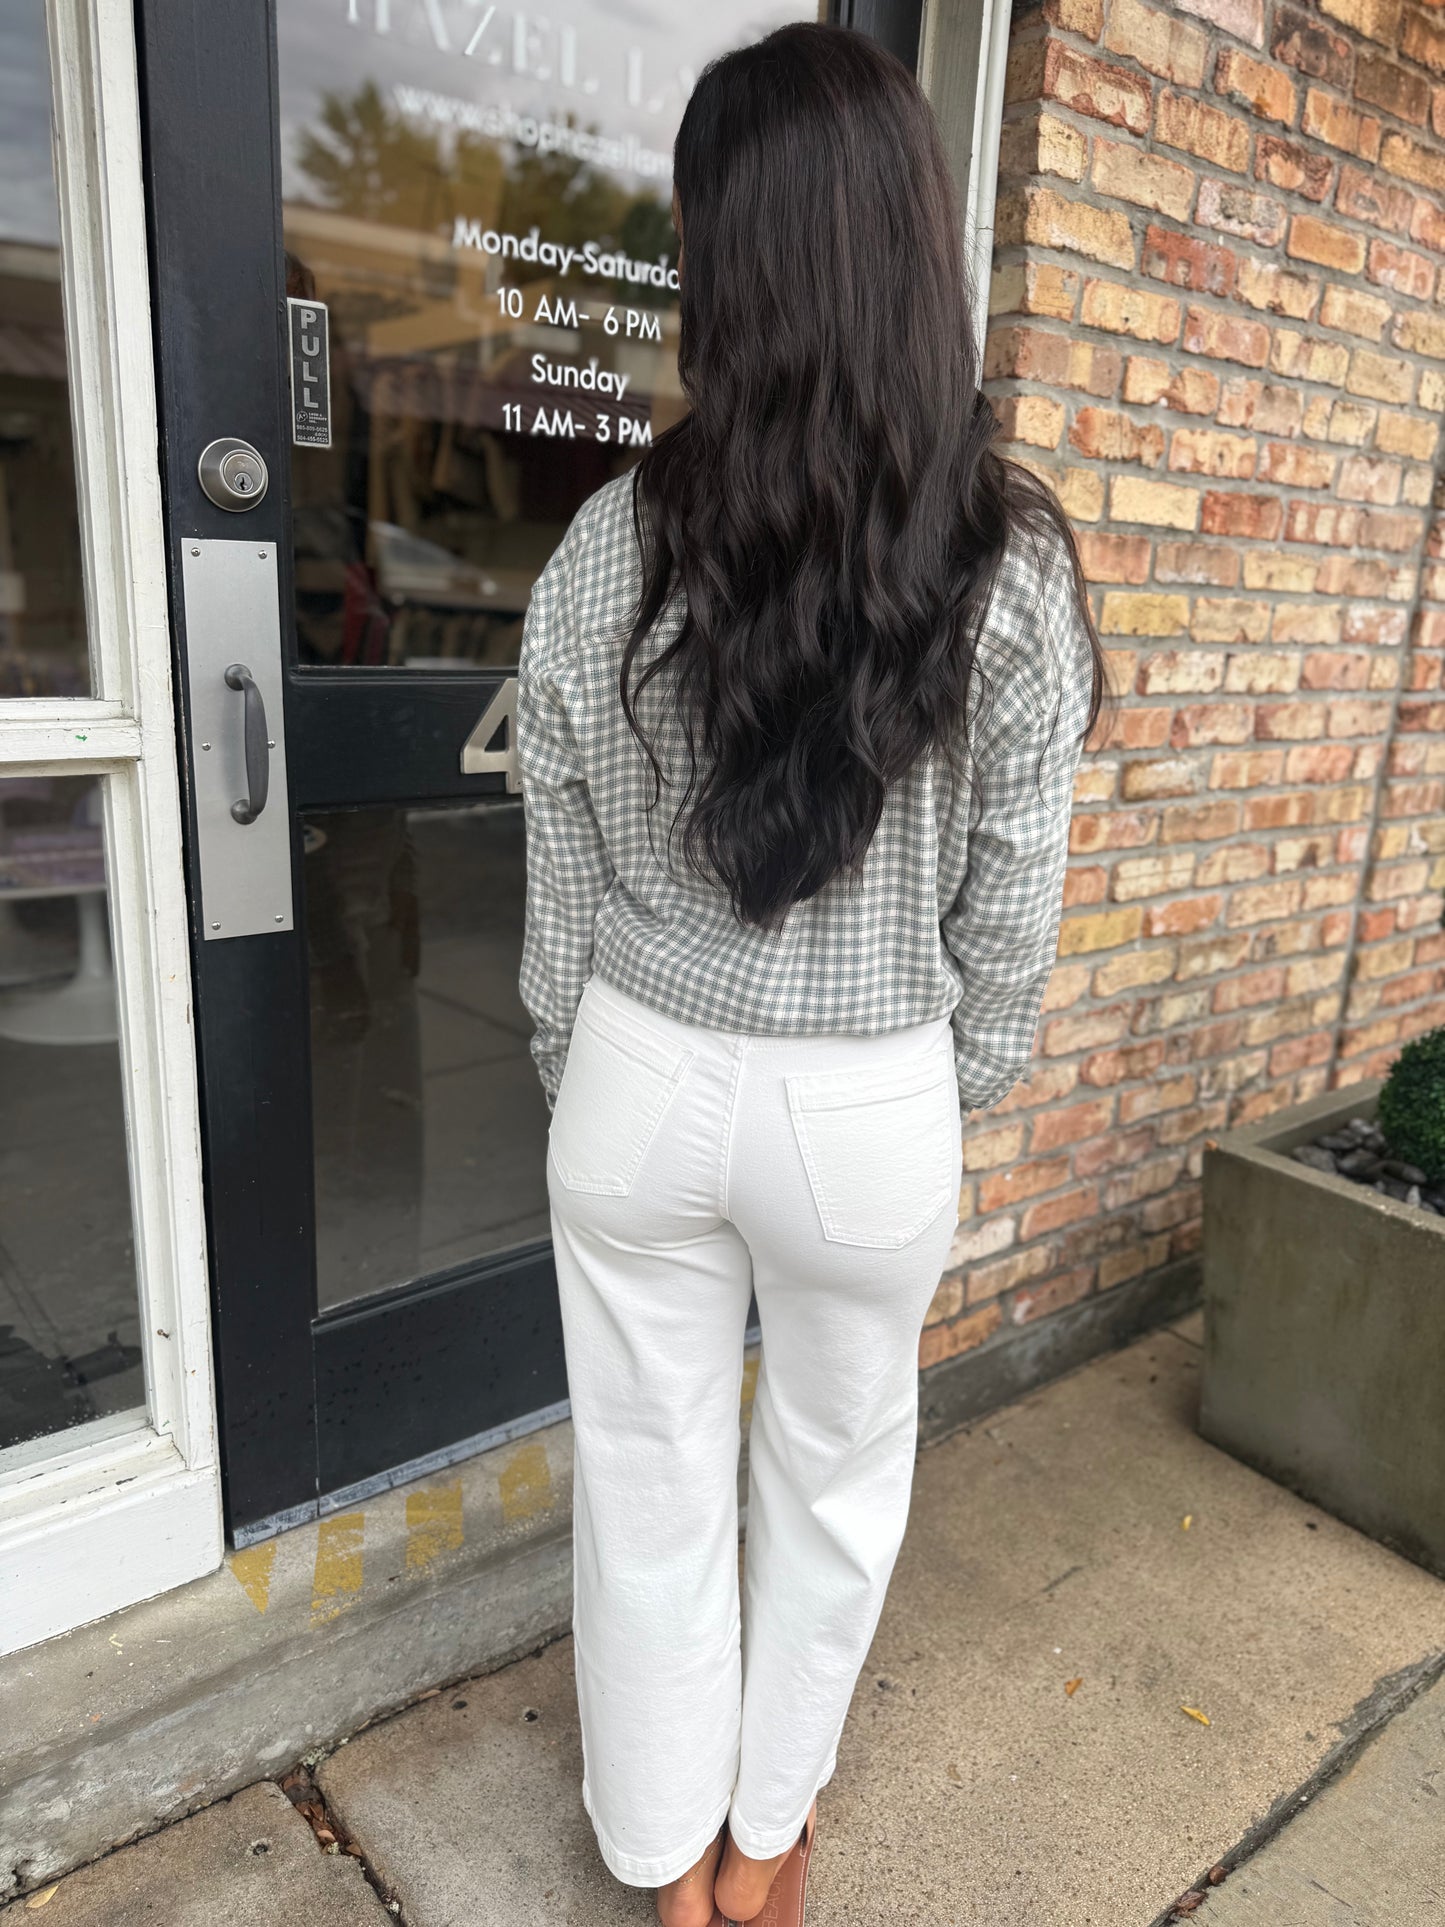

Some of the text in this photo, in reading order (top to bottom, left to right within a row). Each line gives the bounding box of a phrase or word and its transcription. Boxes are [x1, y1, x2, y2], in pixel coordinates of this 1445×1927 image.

[453, 214, 681, 290] Monday-Saturda
[497, 287, 523, 318] 10
[603, 306, 619, 335] 6
[626, 309, 662, 342] PM
[301, 308, 320, 408] PULL
[531, 353, 630, 401] Sunday
[502, 403, 521, 432] 11
[595, 414, 611, 443] 3
[618, 416, 653, 447] PM
[460, 678, 524, 794] 4
[761, 1877, 782, 1927] BEAC
